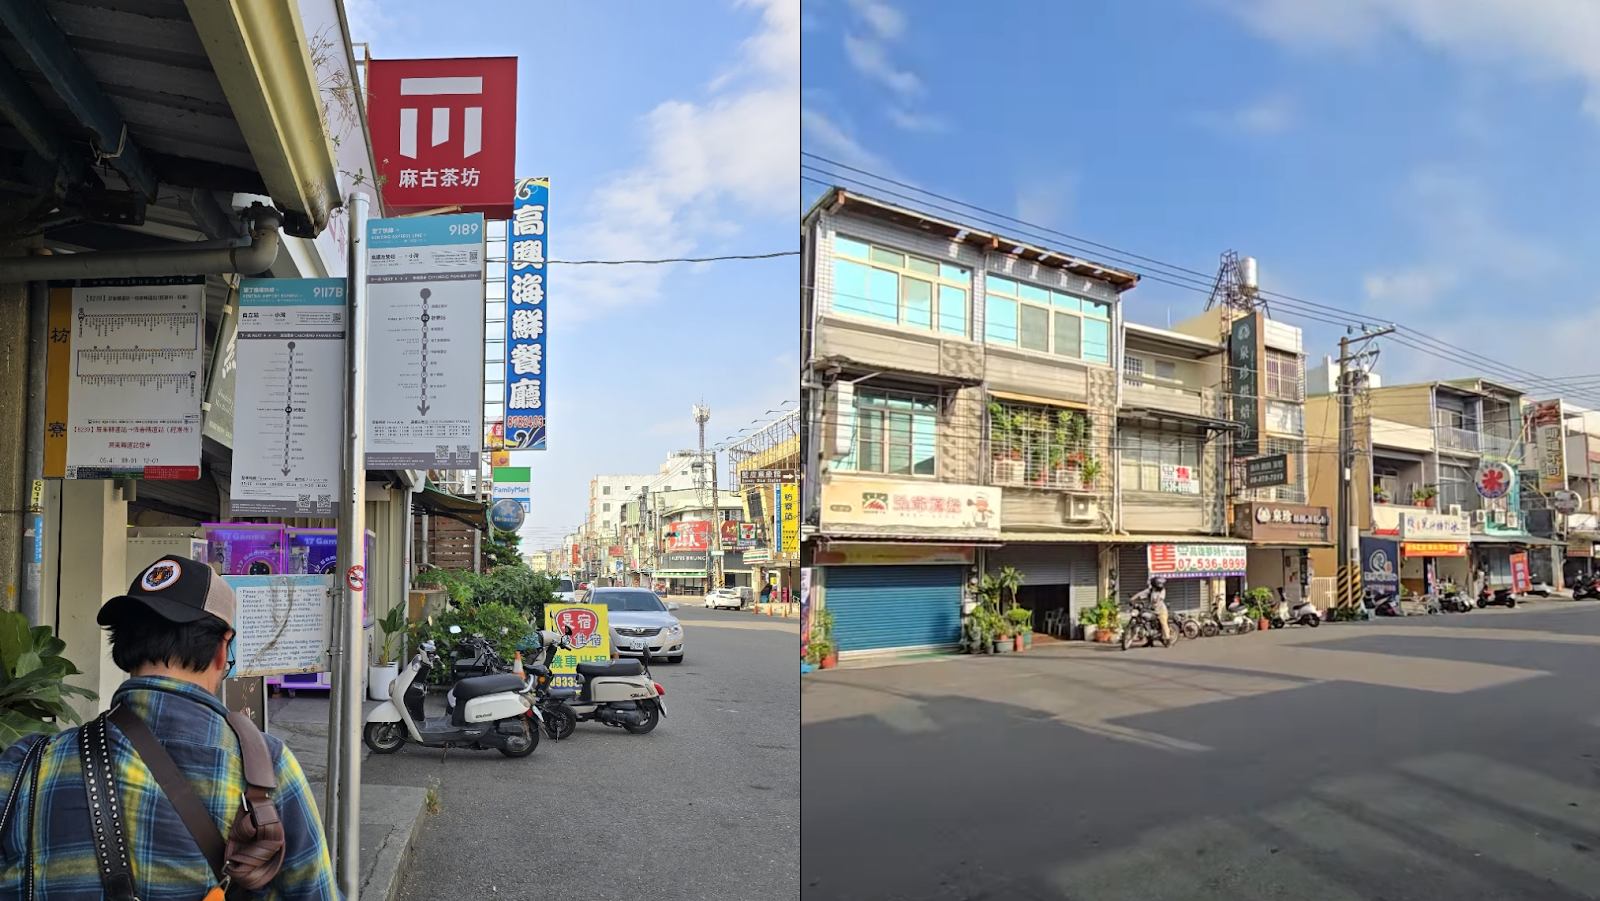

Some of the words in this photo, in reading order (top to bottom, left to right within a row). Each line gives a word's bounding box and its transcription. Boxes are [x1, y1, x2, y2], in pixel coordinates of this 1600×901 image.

[399, 168, 481, 189] 麻古茶坊
[449, 223, 479, 236] 9189
[313, 286, 343, 298] 9117B
[509, 204, 545, 409] 高興海鮮餐廳
[494, 486, 530, 495] FamilyMart
[232, 531, 266, 540] Games
[304, 537, 315, 545] 17
[1150, 544, 1176, 572] 售
[1178, 558, 1246, 570] 07-536-8999
[562, 613, 592, 629] 旻宿
